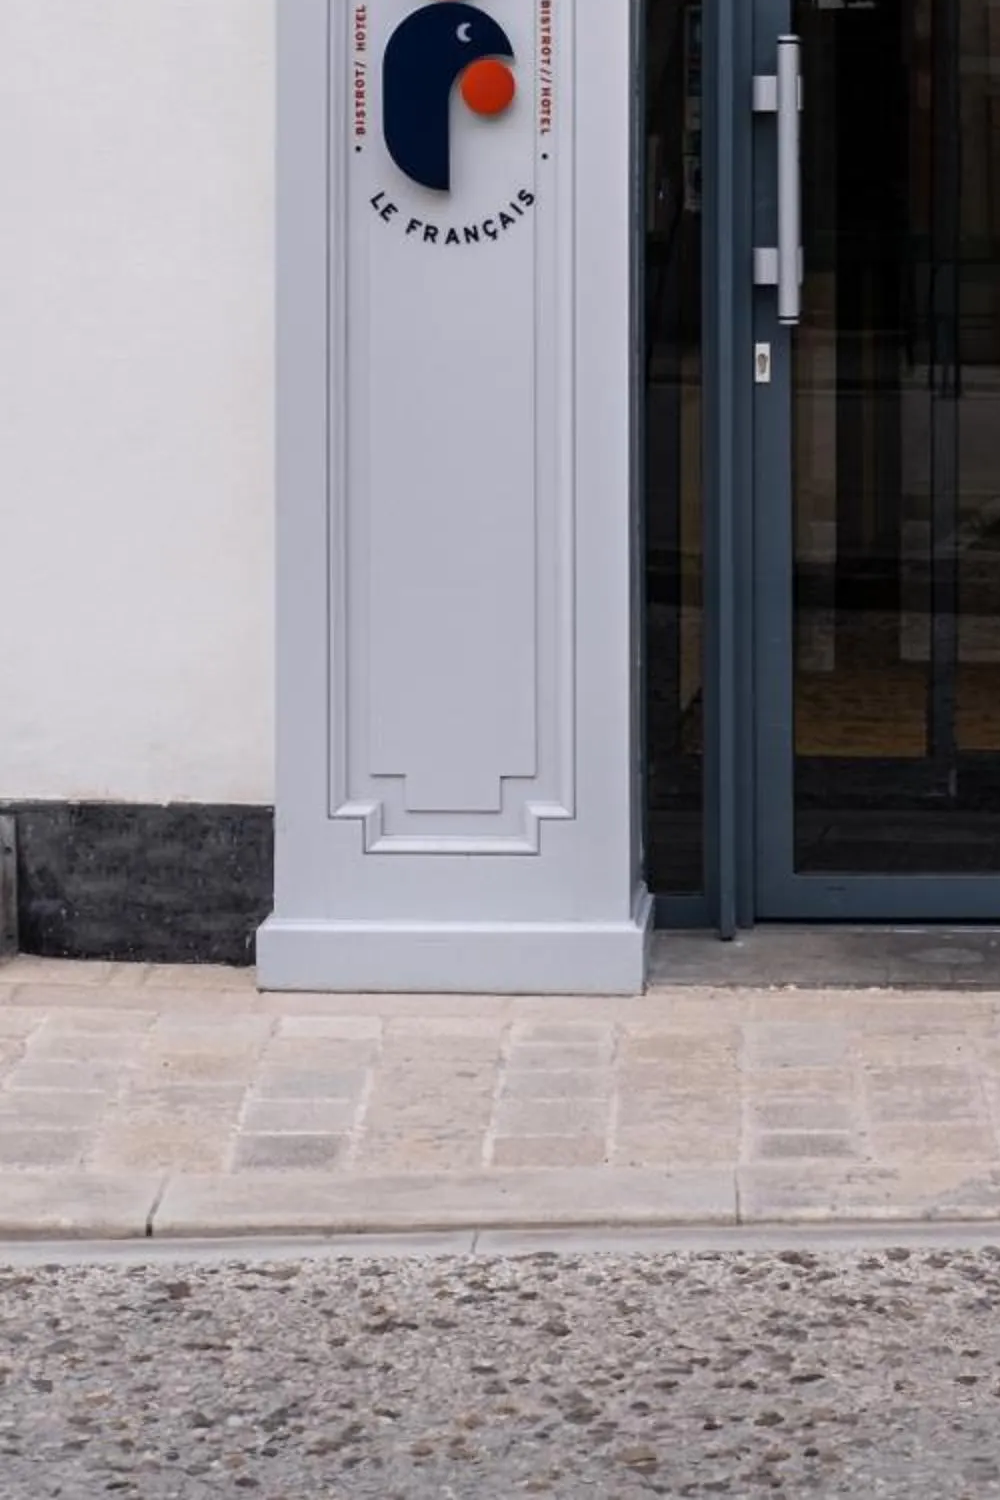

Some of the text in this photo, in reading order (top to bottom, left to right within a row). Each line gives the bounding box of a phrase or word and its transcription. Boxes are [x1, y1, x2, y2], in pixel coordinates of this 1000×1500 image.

[355, 4, 367, 52] HOTEL
[370, 188, 535, 245] LE FRANÇAIS
